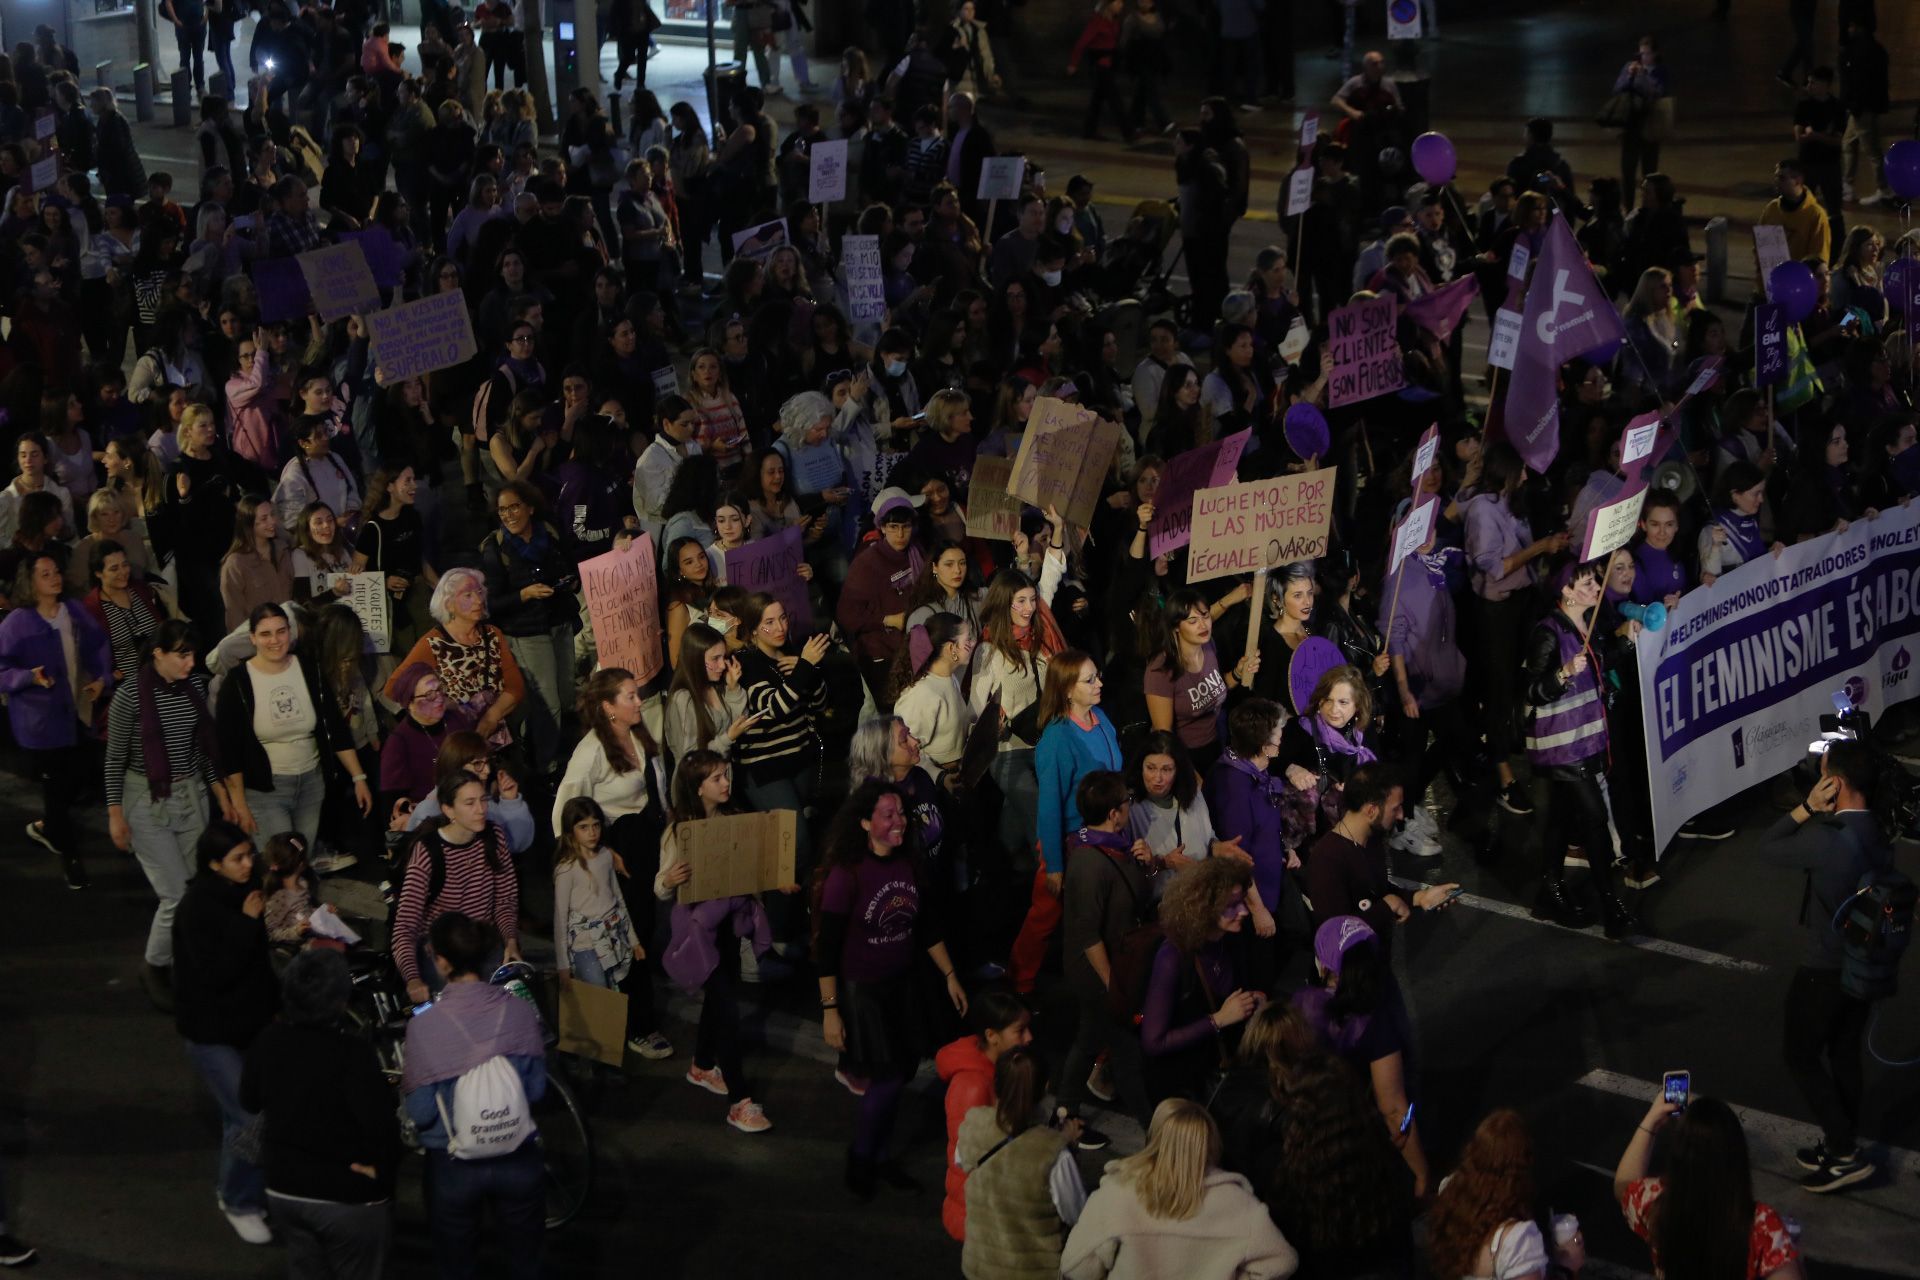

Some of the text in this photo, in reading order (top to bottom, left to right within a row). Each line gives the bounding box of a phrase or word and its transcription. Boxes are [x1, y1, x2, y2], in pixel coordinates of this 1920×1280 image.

[373, 316, 391, 331] NO
[1336, 302, 1391, 339] NO SON
[1333, 326, 1397, 366] CLIENTES
[1762, 331, 1781, 346] 8M
[1333, 353, 1404, 399] SON PUTEROS
[1199, 480, 1324, 516] LUCHEMOS POR
[1212, 503, 1327, 538] LAS MUJERES
[589, 566, 619, 601] ALGO
[620, 561, 632, 586] VA
[1669, 526, 1920, 646] #ELFEMINISMONOVOTATRAIDORES #NOLEY
[600, 639, 621, 659] QUE
[628, 635, 636, 648] A
[1188, 669, 1225, 703] DONA
[1658, 673, 1686, 742] EL
[1690, 600, 1839, 722] FEMINISME
[1191, 694, 1214, 711] HAVIA
[1211, 687, 1221, 697] DE
[470, 1116, 521, 1136] grammar
[480, 1105, 511, 1120] Good
